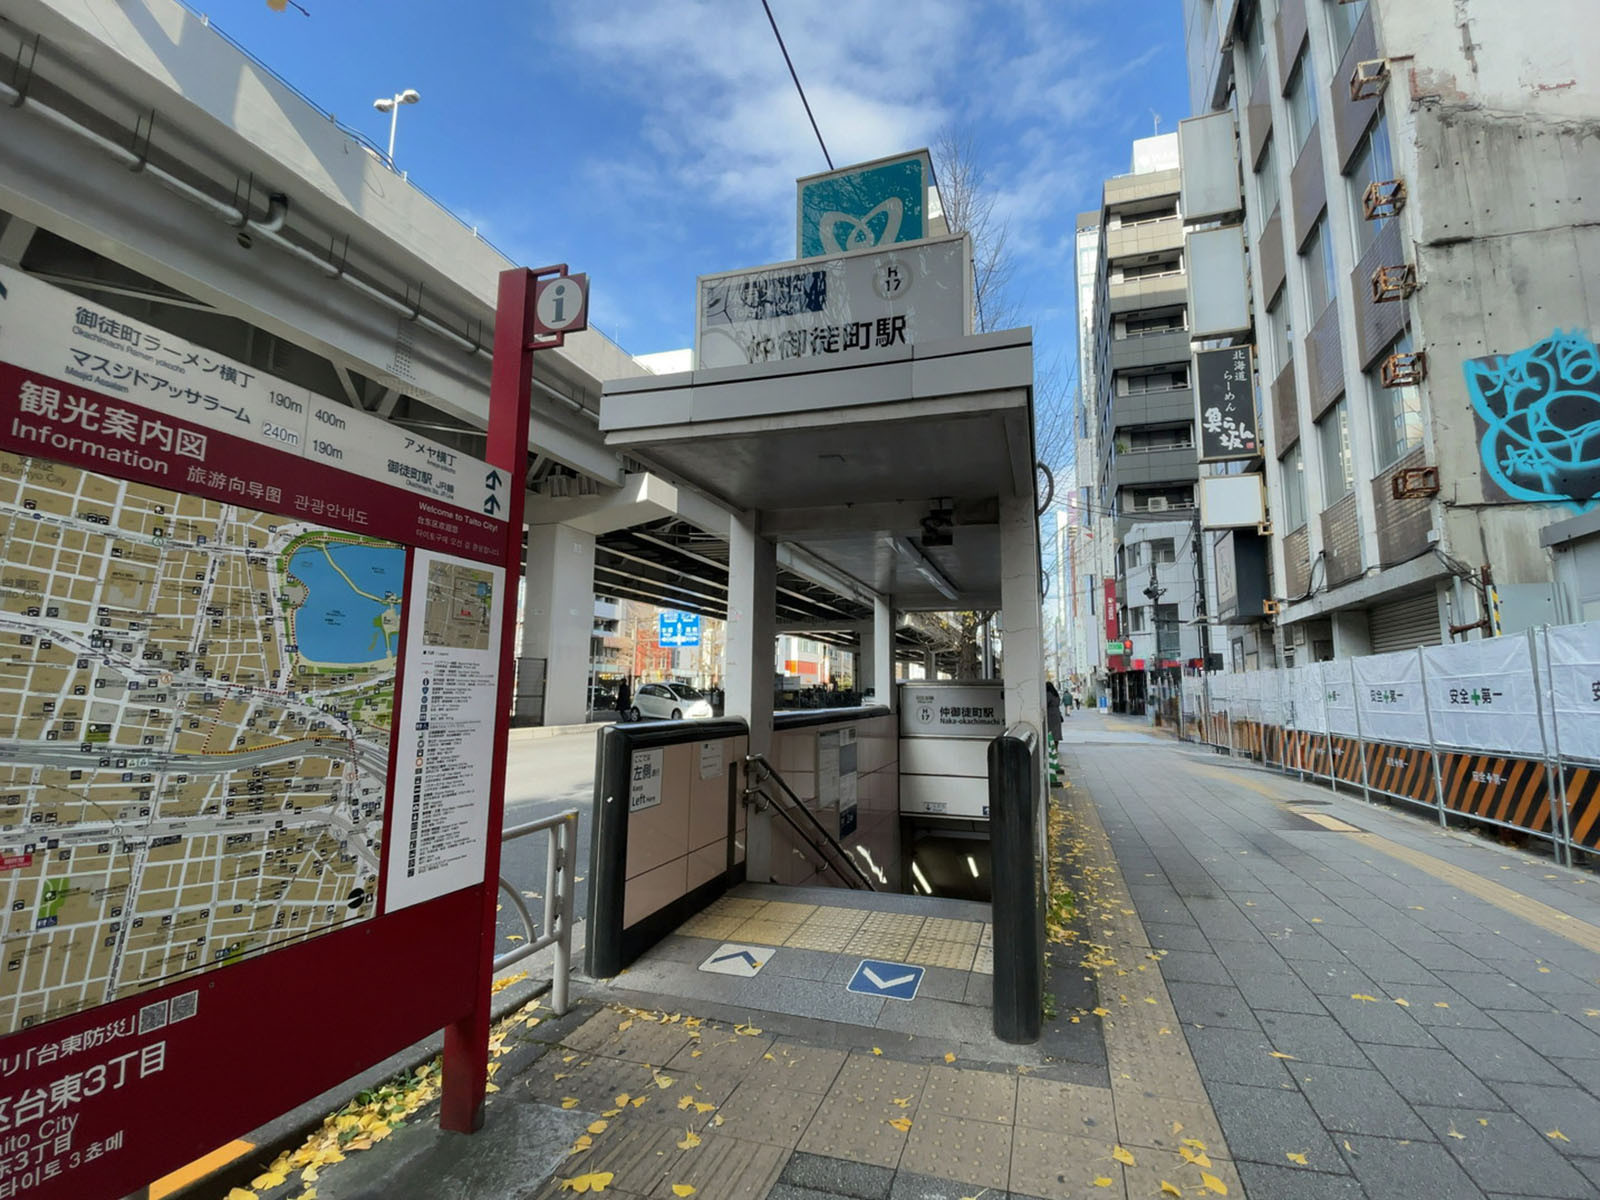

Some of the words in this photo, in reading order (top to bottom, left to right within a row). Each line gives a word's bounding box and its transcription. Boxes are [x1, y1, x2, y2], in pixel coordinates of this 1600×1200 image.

[884, 280, 901, 292] 17
[75, 305, 256, 389] 御徒町ラーメン横丁
[270, 391, 303, 414] 190m
[1232, 350, 1248, 382] 北海道
[69, 346, 251, 424] マスジドアッサラーム
[263, 423, 299, 445] 240m
[1223, 370, 1237, 413] らーめん
[17, 380, 208, 462] 観光案内図
[314, 408, 346, 431] 400m
[11, 417, 169, 475] Information
[312, 439, 343, 460] 190m
[404, 437, 457, 467] アメヤ横丁
[186, 465, 282, 505] 旅游向导图
[387, 459, 433, 486] 御徒町駅
[293, 494, 369, 526] 관광안내도
[418, 501, 453, 520] Welcome
[455, 512, 463, 522] to
[464, 515, 482, 527] Taito
[482, 520, 499, 532] City!
[0, 1014, 137, 1077] リ「台東防災」
[38, 1112, 80, 1140] City
[68, 1151, 81, 1169] 3
[83, 1130, 124, 1164] 초메
